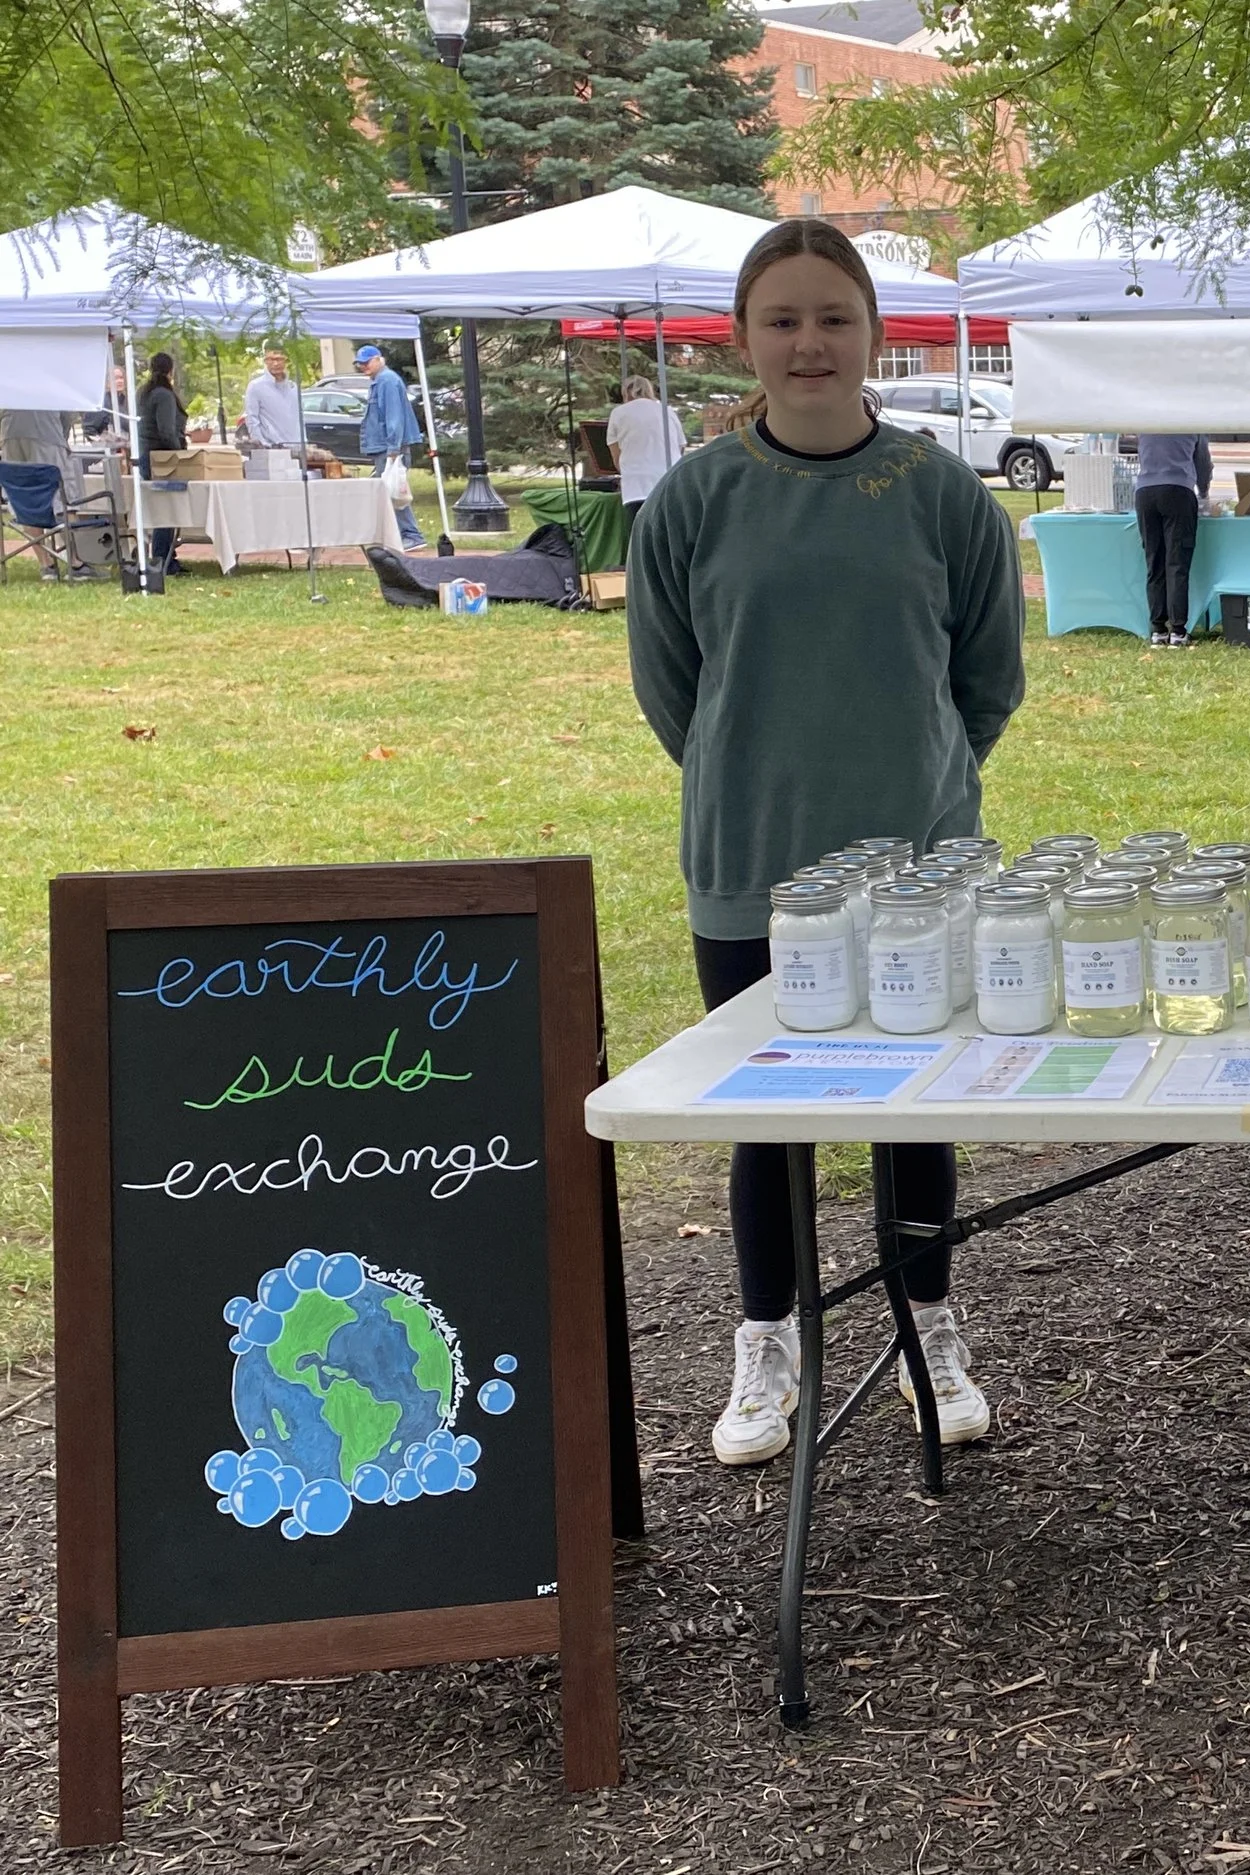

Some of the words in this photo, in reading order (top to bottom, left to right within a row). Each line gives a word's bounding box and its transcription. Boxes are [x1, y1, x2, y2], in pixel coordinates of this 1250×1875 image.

[117, 930, 518, 1030] earthly
[184, 1028, 473, 1110] suds
[793, 1051, 934, 1062] purplebrown
[122, 1134, 538, 1199] exchange
[360, 1256, 431, 1308] earthly
